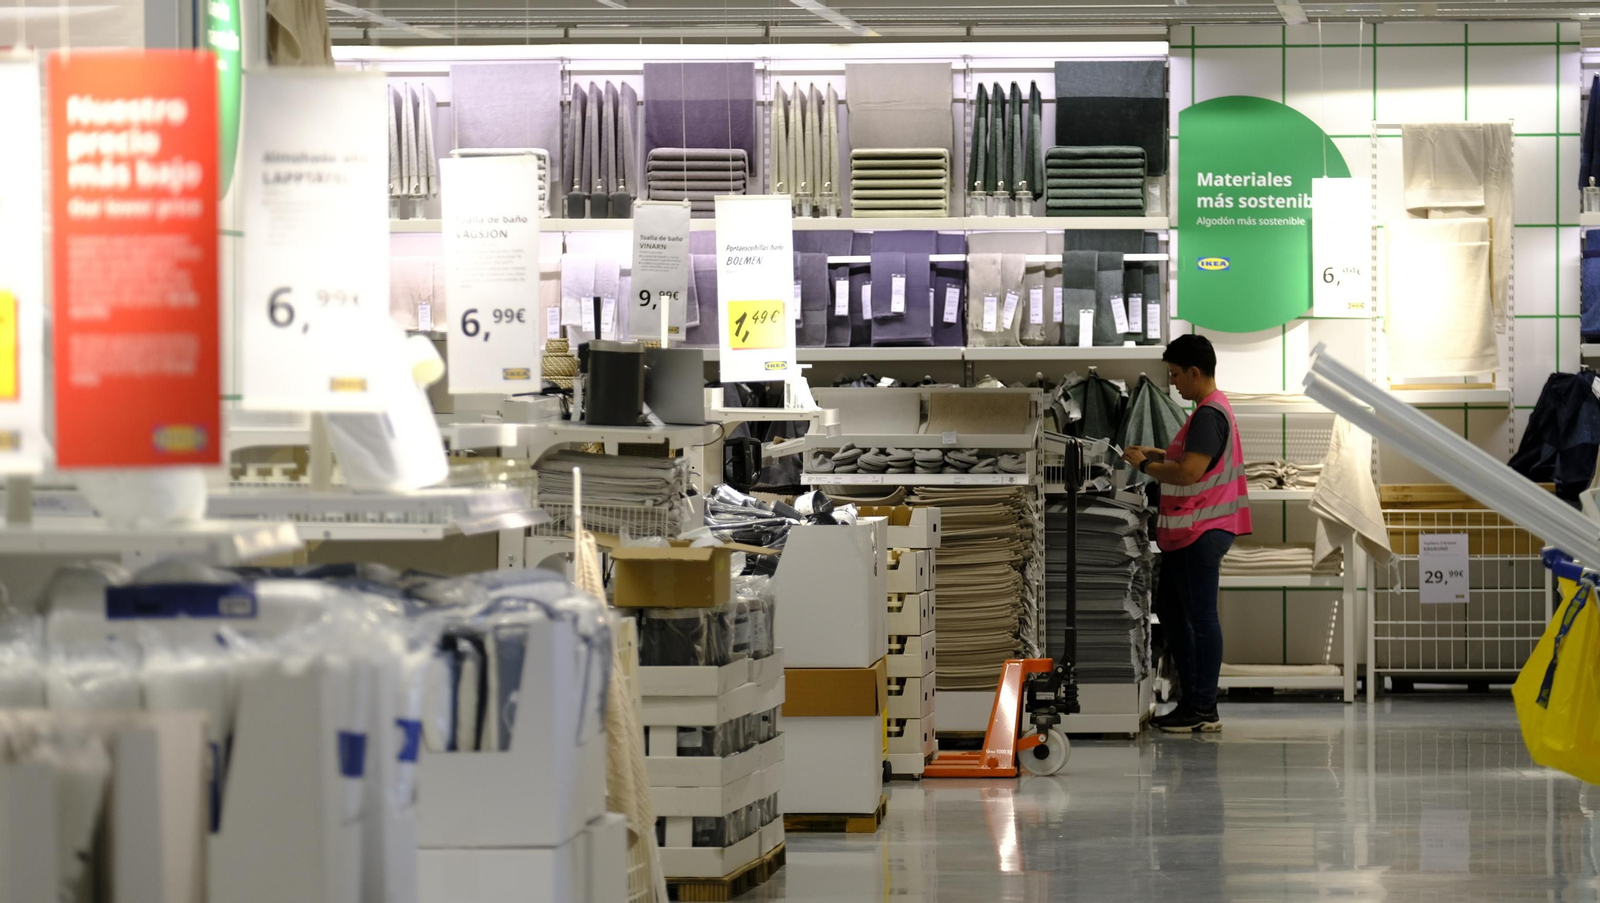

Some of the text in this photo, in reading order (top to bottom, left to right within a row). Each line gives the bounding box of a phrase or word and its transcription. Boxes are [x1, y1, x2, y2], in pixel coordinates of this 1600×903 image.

[67, 95, 187, 124] Nuestro
[67, 129, 160, 162] precio
[136, 160, 201, 193] bajo
[1197, 171, 1292, 187] Materiales
[1197, 193, 1234, 208] más
[487, 216, 500, 224] de
[503, 214, 528, 224] baño
[1196, 217, 1306, 227] Algodón más sostenible
[726, 256, 764, 266] BOLMEN
